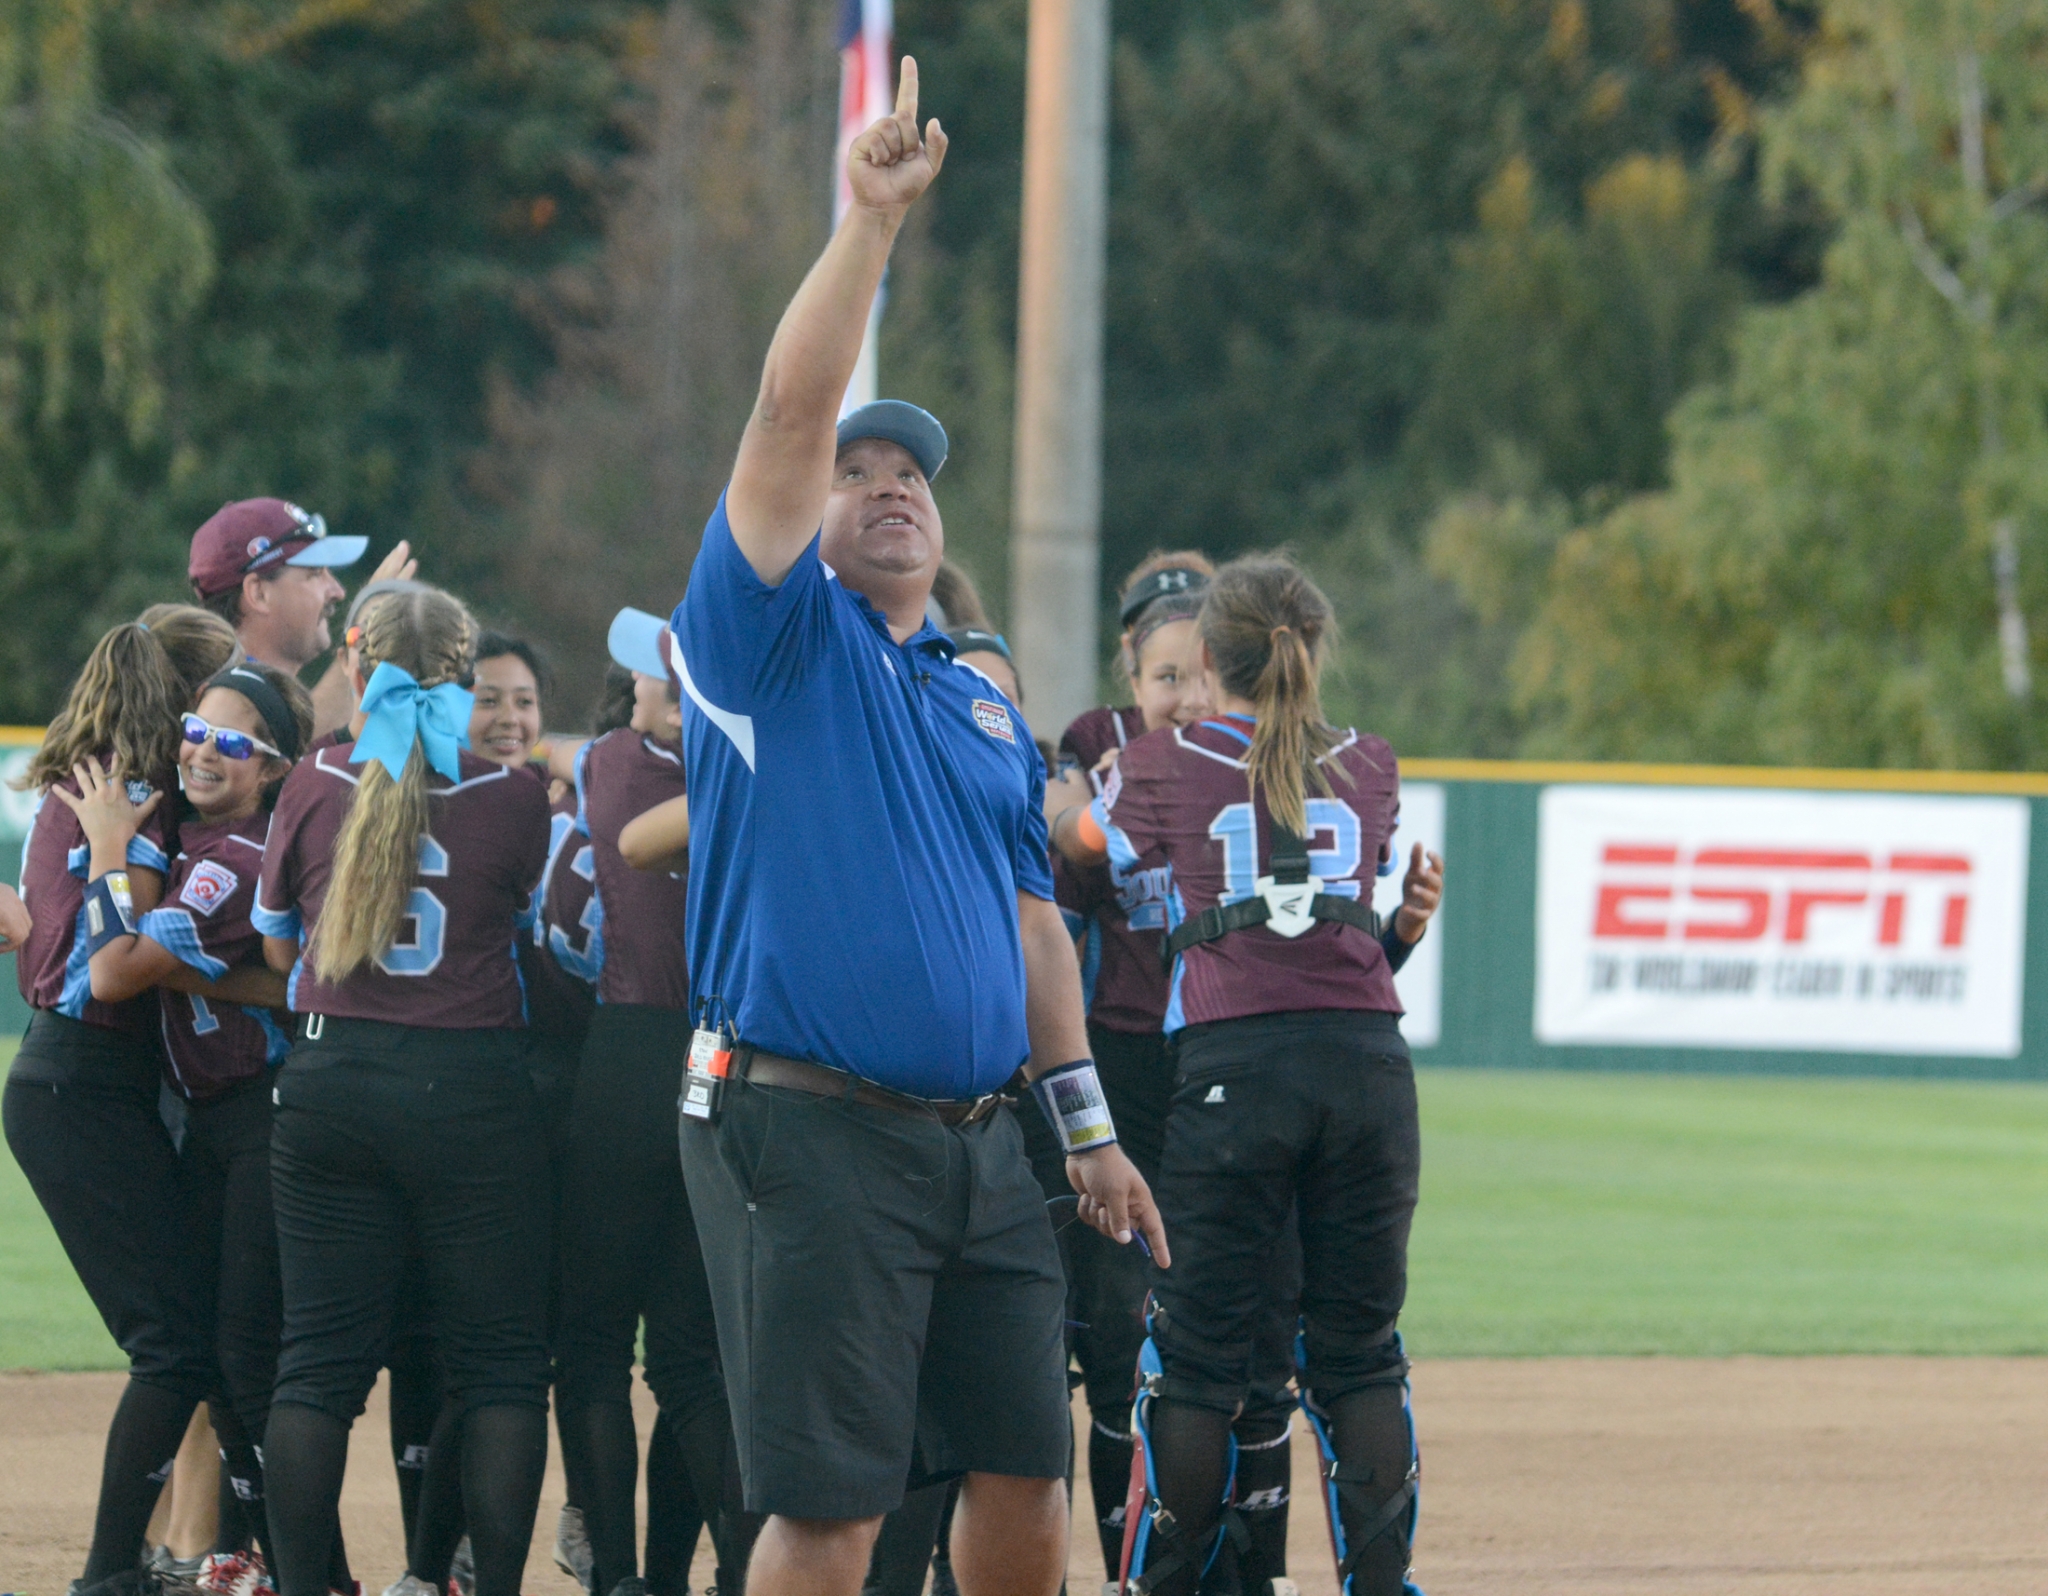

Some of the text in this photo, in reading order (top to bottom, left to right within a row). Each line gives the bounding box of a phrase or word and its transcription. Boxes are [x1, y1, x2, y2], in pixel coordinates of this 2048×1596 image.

[373, 832, 449, 977] 6
[1208, 797, 1362, 908] 12
[1592, 843, 1973, 948] ESPN
